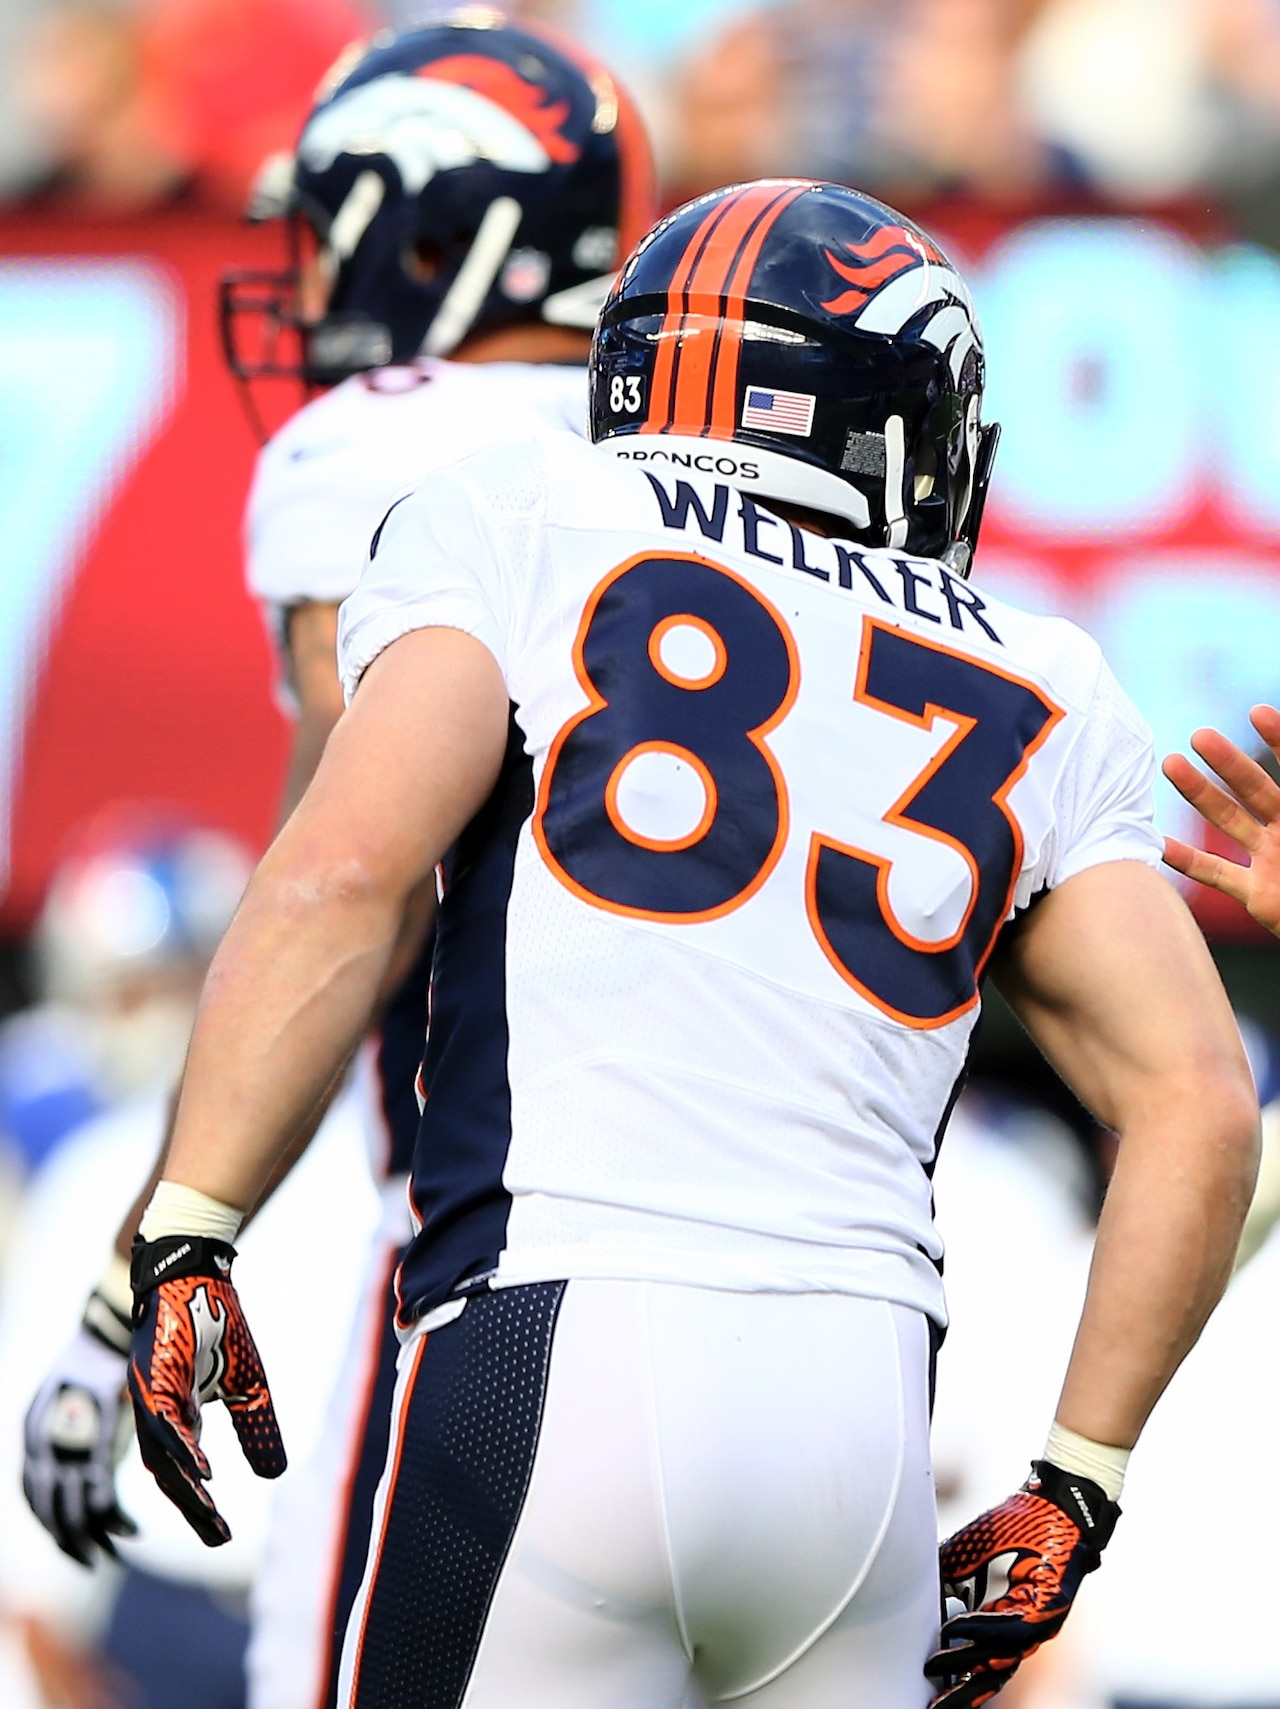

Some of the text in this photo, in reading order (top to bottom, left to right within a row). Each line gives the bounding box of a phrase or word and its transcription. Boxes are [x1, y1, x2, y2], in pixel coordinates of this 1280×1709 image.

[610, 375, 642, 413] 83
[641, 468, 1005, 648] WELKER
[532, 549, 1067, 1031] 83
